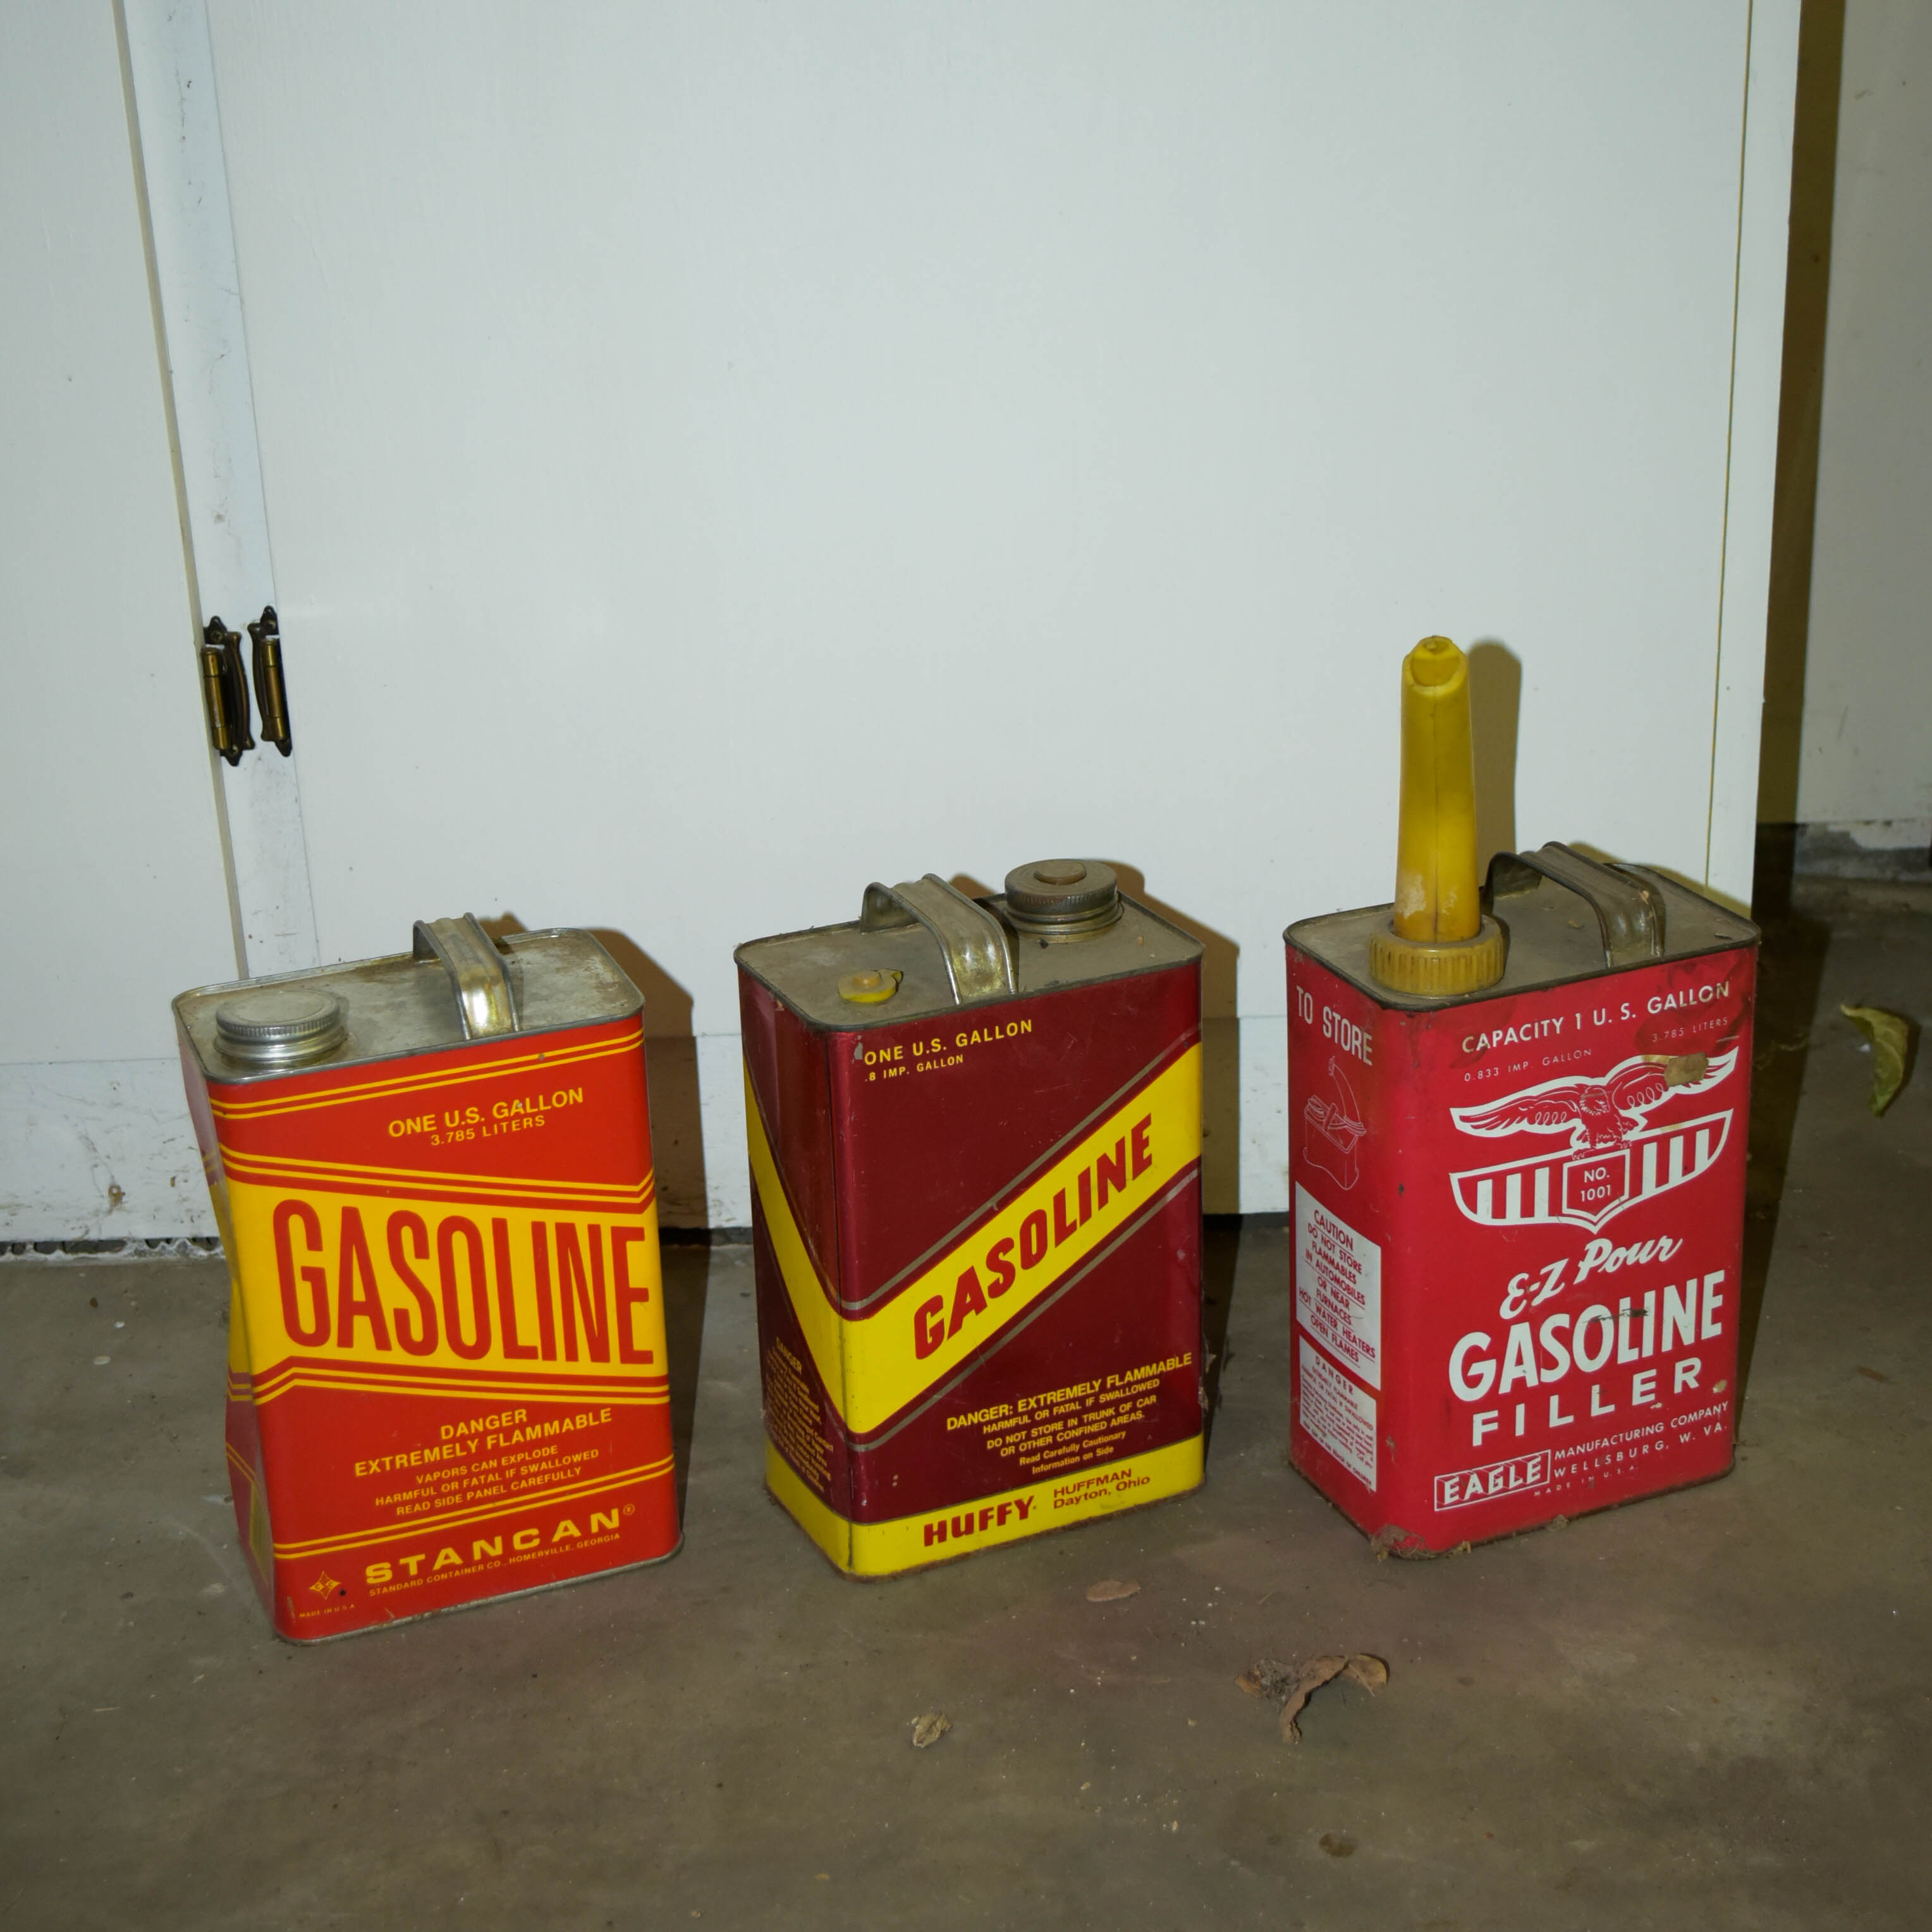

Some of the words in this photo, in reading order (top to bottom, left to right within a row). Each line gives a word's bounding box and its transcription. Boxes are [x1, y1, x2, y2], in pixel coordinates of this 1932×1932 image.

[1296, 985, 1313, 1025] TO
[1323, 1006, 1373, 1067] STORE
[1462, 1017, 1564, 1053] CAPACITY
[1575, 1013, 1582, 1030] 1
[1647, 981, 1730, 1015] GALLON
[1652, 1027, 1684, 1042] 3.785
[1692, 1017, 1728, 1034] LITERS
[864, 1046, 903, 1065] ONE
[912, 1038, 947, 1056] U.S.
[956, 1019, 1032, 1047] GALLON
[1542, 1048, 1593, 1066] GALLON
[883, 1067, 909, 1079] IMP.
[917, 1055, 963, 1072] GALLON
[388, 1114, 437, 1137] ONE
[444, 1107, 486, 1127] U.S.
[492, 1087, 584, 1118] GALLON
[431, 1128, 475, 1146] 3.785
[482, 1115, 546, 1137] LITERS
[1580, 1184, 1611, 1202] 1001
[1584, 1167, 1610, 1183] NO.
[914, 1113, 1152, 1360] GASOLINE
[1307, 1222, 1318, 1238] DO
[1321, 1234, 1335, 1253] NOT
[1339, 1249, 1362, 1275] STORE
[1314, 1209, 1353, 1251] CAUTION
[272, 1199, 654, 1365] GASOLINE
[1305, 1248, 1312, 1263] IN
[1316, 1259, 1366, 1305] AUTOMOBILES
[1312, 1240, 1356, 1285] FLAMMABLES
[1499, 1258, 1569, 1320] E-Z
[1573, 1235, 1684, 1285] Pour
[1316, 1288, 1352, 1326] FURNACES
[1318, 1276, 1327, 1290] OR
[1331, 1287, 1350, 1310] NEAR
[1299, 1287, 1311, 1305] HOT
[1315, 1303, 1338, 1330] WATER
[1343, 1326, 1376, 1359] HEATERS
[1311, 1315, 1328, 1337] OPEN
[1331, 1333, 1359, 1362] FLAMES
[1448, 1269, 1727, 1402] GASOLINE
[947, 1403, 1013, 1431] DANGER:
[1018, 1378, 1103, 1412] EXTREMELY
[1106, 1352, 1192, 1389] FLAMMABLE
[1316, 1355, 1354, 1395] DANGER
[441, 1409, 527, 1440] DANGER
[983, 1415, 1031, 1434] HARMFUL
[1035, 1409, 1049, 1421] OR
[1053, 1402, 1082, 1416] FATAL
[1085, 1397, 1096, 1407] IF
[1099, 1378, 1160, 1403] SWALLOWED
[987, 1438, 1003, 1450] DO
[1006, 1431, 1027, 1445] NOT
[1031, 1422, 1064, 1438] STORE
[1068, 1417, 1078, 1428] IN
[1083, 1407, 1116, 1424] TRUNK
[1119, 1402, 1133, 1414] OF
[1137, 1395, 1157, 1410] CAR
[1472, 1357, 1702, 1446] FILLER
[354, 1438, 479, 1477] EXTREMELY
[486, 1407, 613, 1450] FLAMMABLE
[1000, 1445, 1015, 1457] OR
[1019, 1436, 1053, 1453] OTHER
[1056, 1421, 1107, 1442] CONFINED
[1110, 1410, 1145, 1431] AREAS.
[1020, 1453, 1041, 1466] Read
[1043, 1442, 1080, 1460] Carefully
[1083, 1430, 1127, 1449] Cautionary
[1554, 1422, 1665, 1461] MANUFACTURING
[1671, 1401, 1729, 1429] COMPANY
[375, 1486, 437, 1507] HARMFUL
[441, 1482, 459, 1493] OR
[463, 1472, 502, 1489] FATAL
[506, 1469, 517, 1479] IF
[520, 1449, 599, 1475] SWALLOWED
[416, 1465, 468, 1484] VAPORS
[471, 1458, 498, 1473] CAN
[501, 1445, 559, 1466] EXPLODE
[1032, 1454, 1080, 1474] Information
[1083, 1452, 1094, 1460] on
[1096, 1445, 1114, 1458] Side
[1054, 1469, 1132, 1498] HUFFMAN
[1441, 1453, 1543, 1505] EAGLE
[396, 1501, 431, 1516] READ
[434, 1495, 463, 1509] SIDE
[467, 1484, 506, 1502] PANEL
[511, 1466, 582, 1491] CAREFULLY
[1053, 1486, 1111, 1509] Dayton,
[1115, 1475, 1151, 1492] Ohio
[1534, 1482, 1572, 1496] MADE
[924, 1495, 1034, 1547] HUFFY
[369, 1578, 424, 1597] STANDARD
[426, 1564, 484, 1583] CONTAINER
[577, 1532, 621, 1549] GEORGIA
